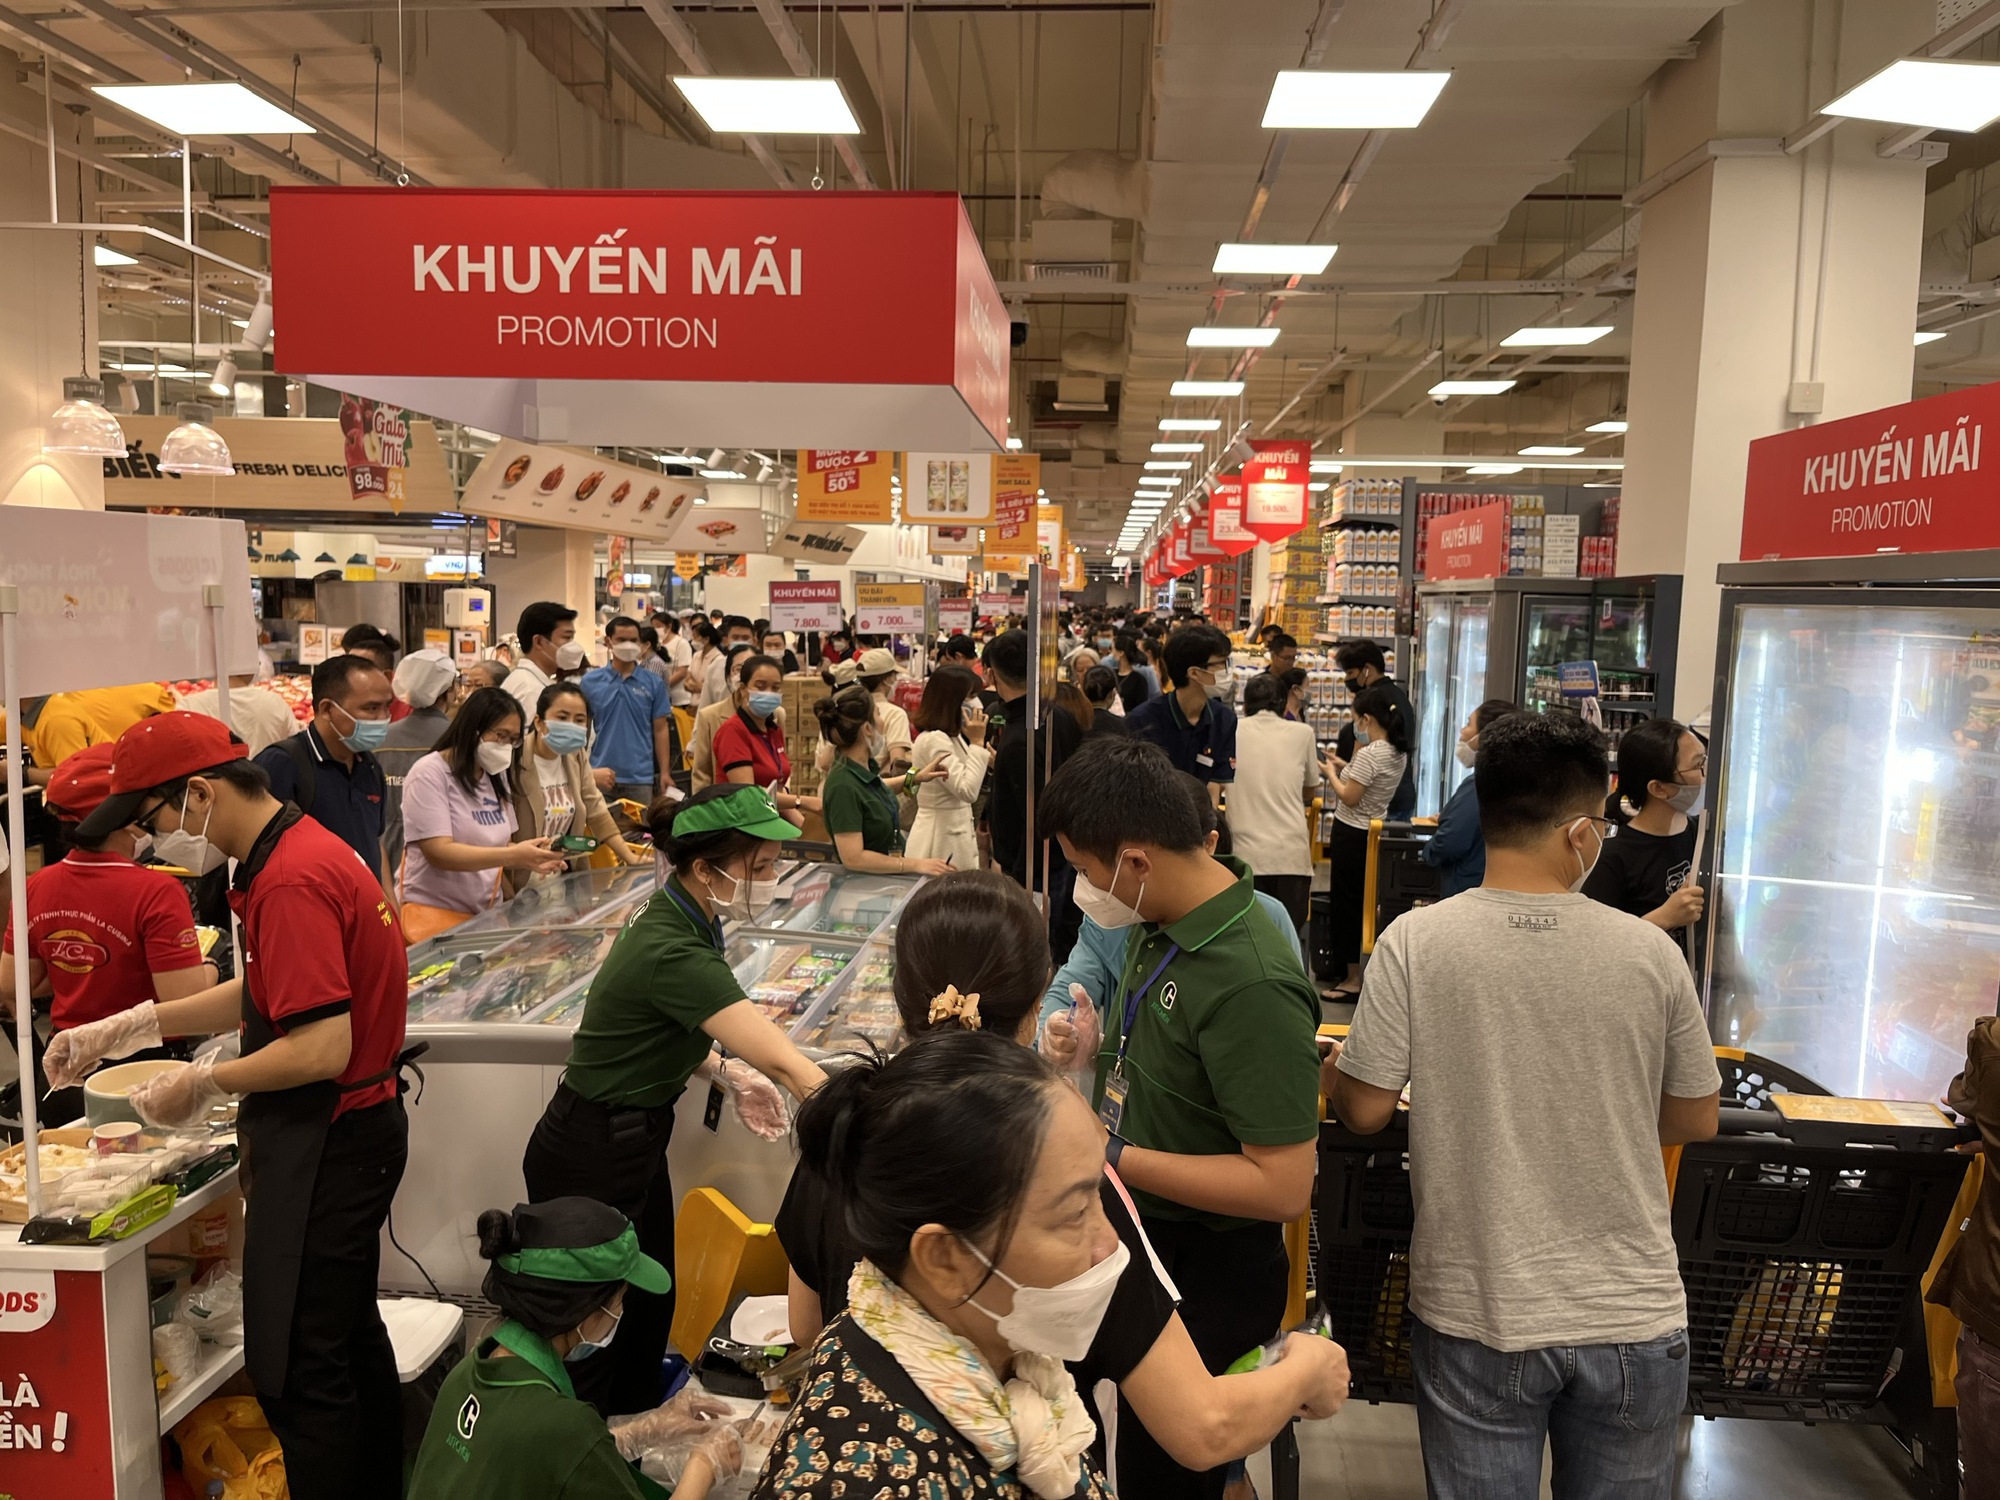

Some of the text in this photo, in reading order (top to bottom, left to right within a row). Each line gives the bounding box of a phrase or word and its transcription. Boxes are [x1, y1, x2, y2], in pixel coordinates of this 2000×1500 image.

[413, 229, 802, 296] KHUYẾN MÃI
[498, 316, 718, 350] PROMOTION
[374, 411, 406, 439] Gala
[816, 456, 851, 470] ĐƯỢC
[1254, 449, 1299, 464] KHUYẾN
[1803, 415, 1982, 495] KHUYẾN MÃI
[234, 464, 294, 476] FRESH
[296, 464, 348, 478] DELICI
[1264, 466, 1288, 480] MÃI
[828, 476, 856, 492] 50%
[1016, 509, 1026, 522] 2
[1831, 497, 1932, 533] PROMOTION
[1441, 520, 1468, 549] KHUYẾN
[774, 587, 836, 598] KHUYẾN MÃI
